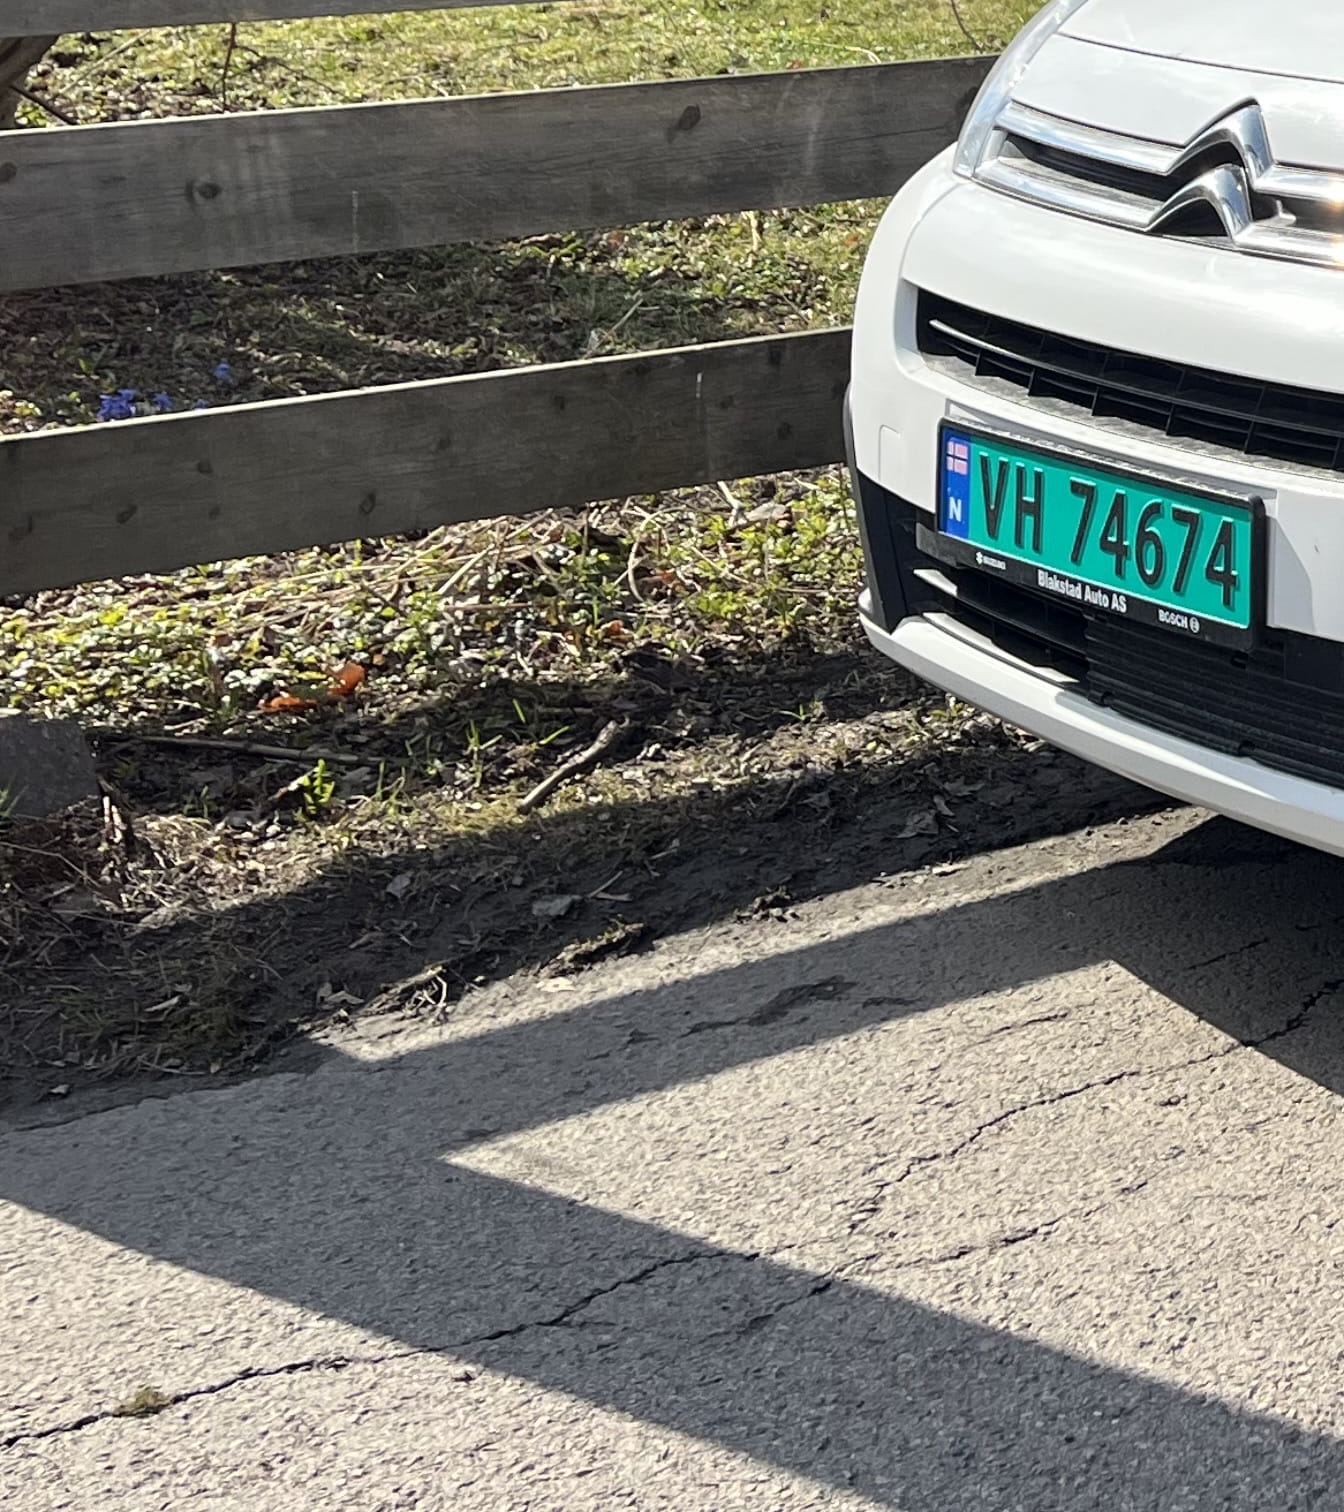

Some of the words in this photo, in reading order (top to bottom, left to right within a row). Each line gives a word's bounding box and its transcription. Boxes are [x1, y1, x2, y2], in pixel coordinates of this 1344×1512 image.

[948, 496, 963, 522] N
[979, 451, 1046, 554] VH
[1069, 476, 1240, 610] 74674
[1037, 568, 1082, 600] Blakstad
[1083, 584, 1110, 608] Auto
[1111, 593, 1127, 613] AS
[1157, 608, 1188, 629] BOSCH
